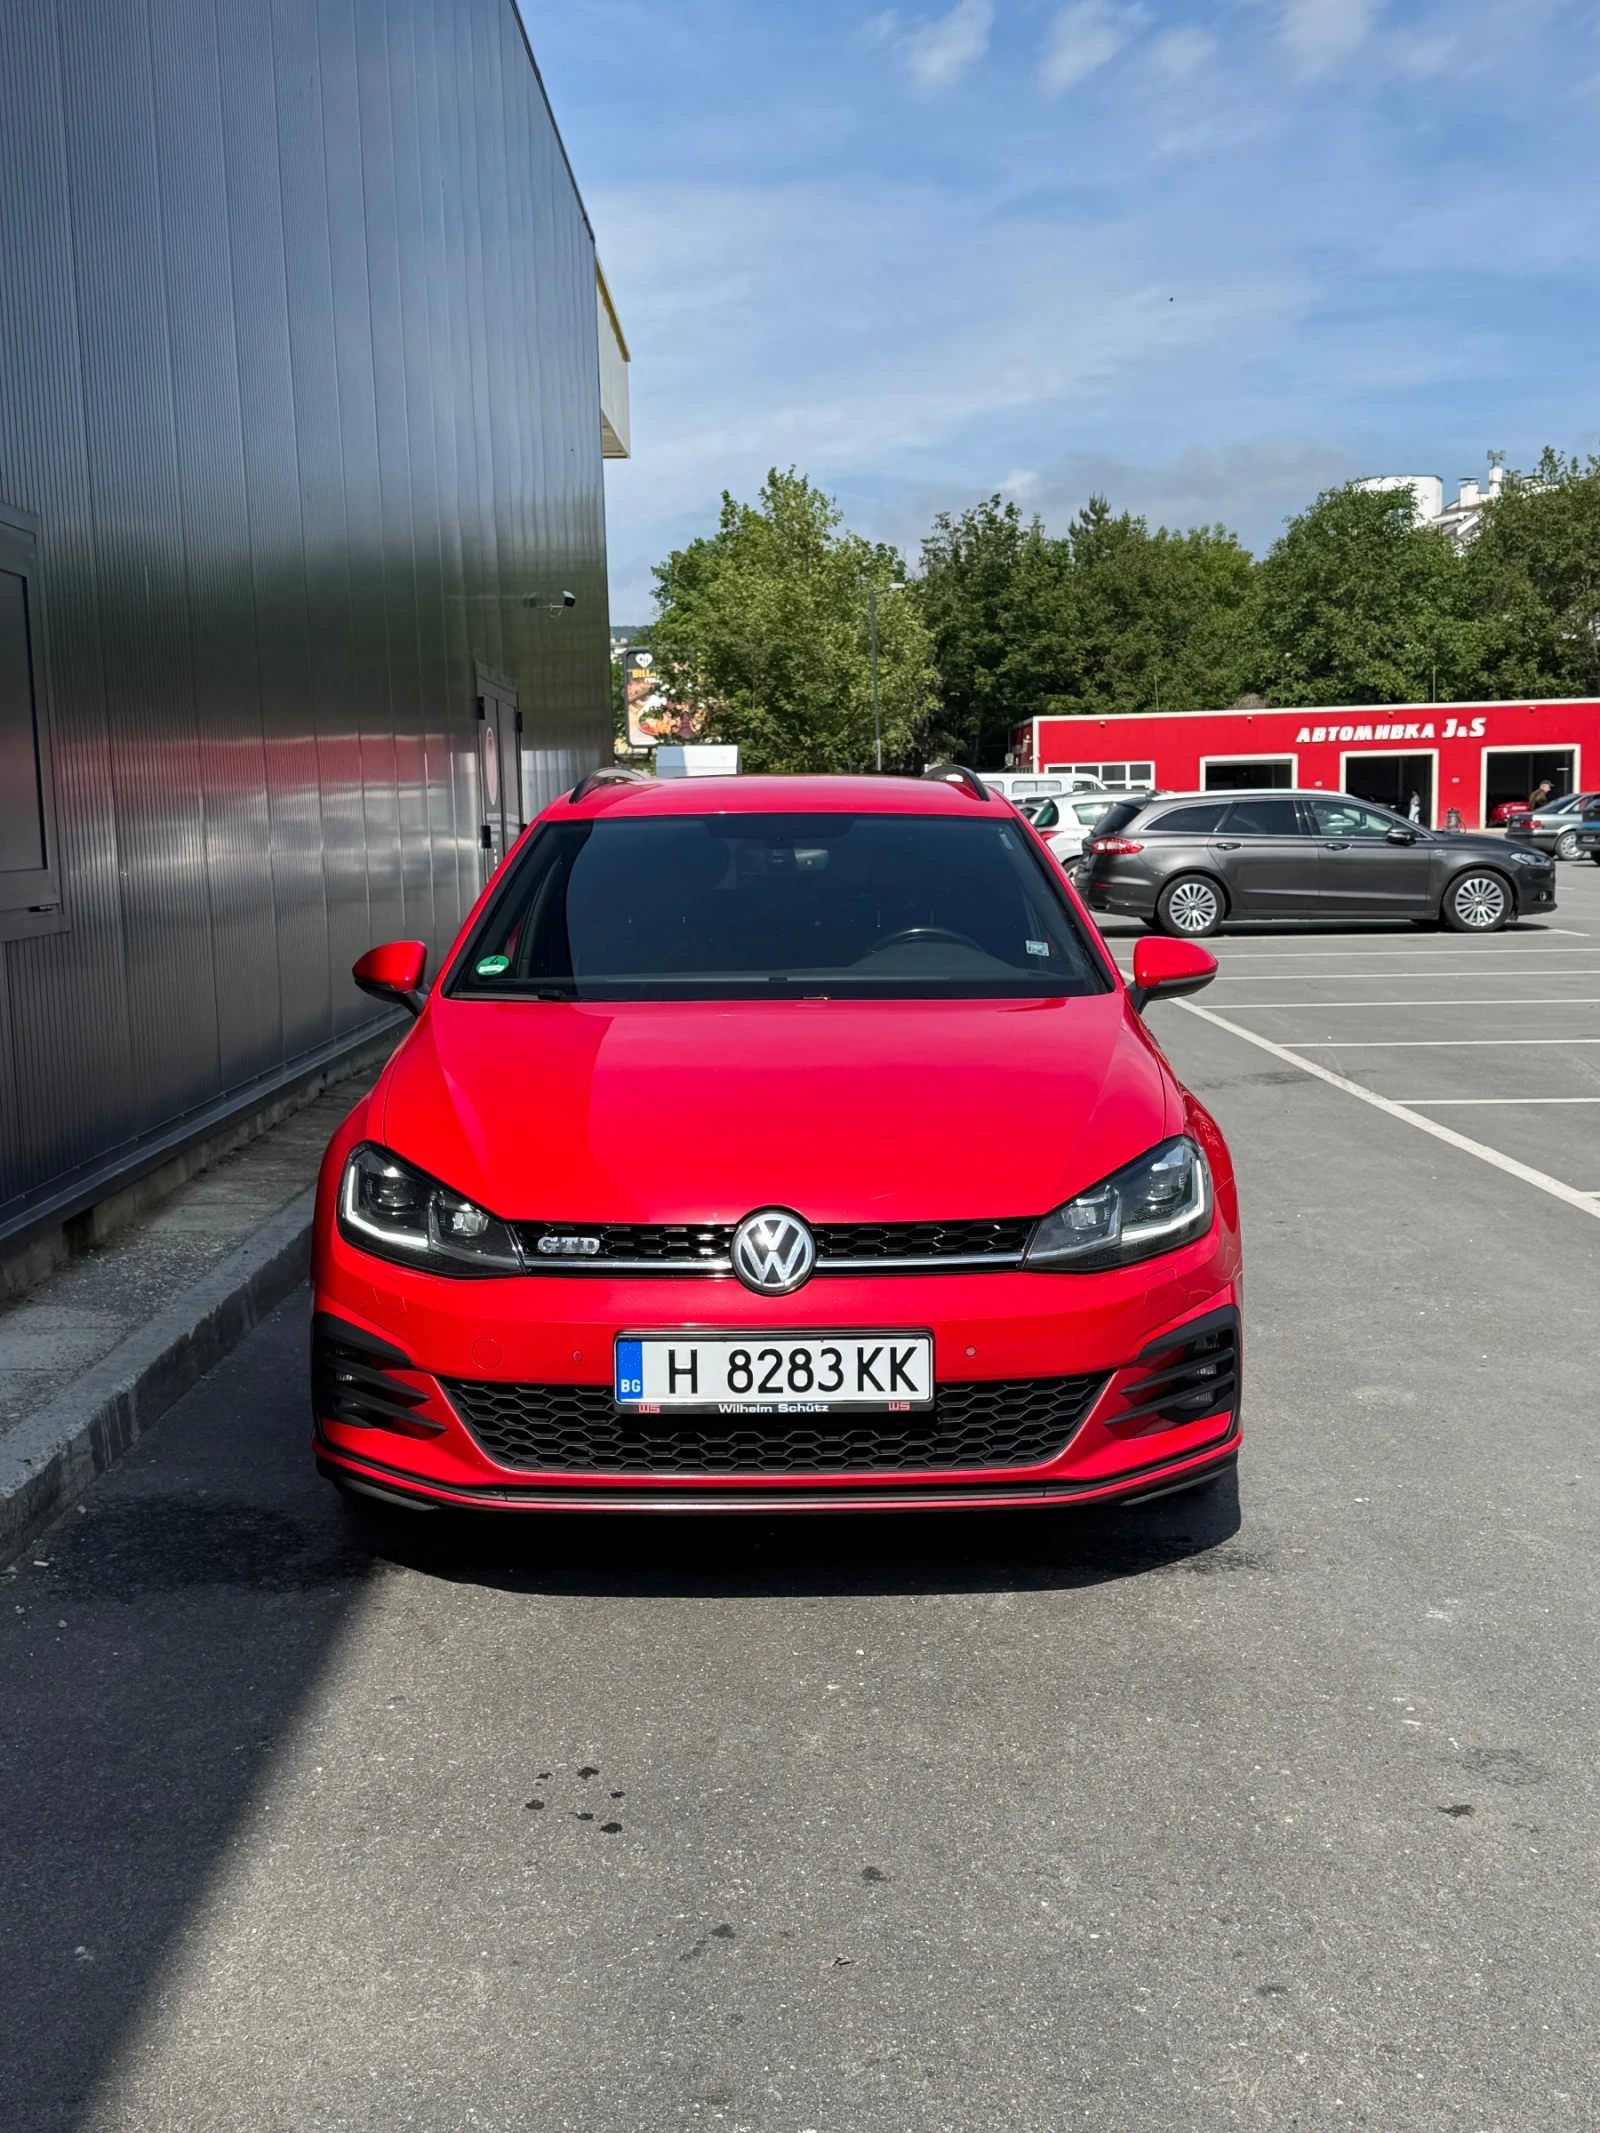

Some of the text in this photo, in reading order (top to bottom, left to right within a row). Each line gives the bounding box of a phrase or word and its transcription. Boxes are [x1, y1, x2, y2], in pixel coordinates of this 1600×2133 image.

[1295, 717, 1487, 743] АВТОМИВКА J&S
[537, 1236, 600, 1255] GTD
[668, 1346, 919, 1394] H 8283 KK
[620, 1378, 642, 1393] BG
[638, 1404, 661, 1414] WS
[718, 1402, 829, 1413] Wilhelm Schütz
[888, 1401, 911, 1411] WS
